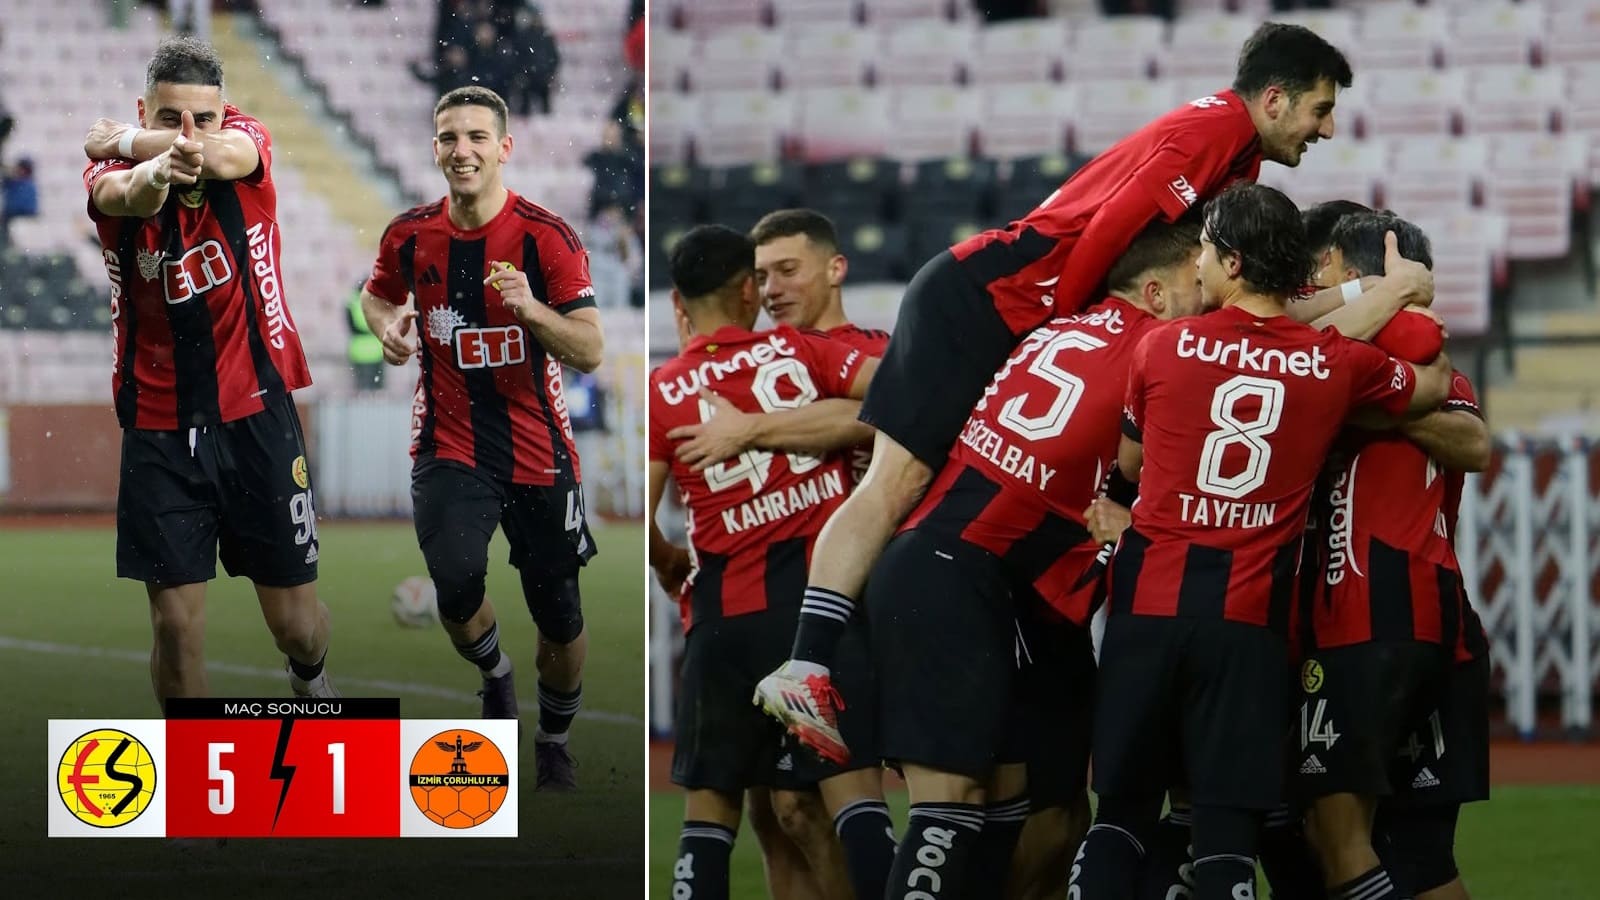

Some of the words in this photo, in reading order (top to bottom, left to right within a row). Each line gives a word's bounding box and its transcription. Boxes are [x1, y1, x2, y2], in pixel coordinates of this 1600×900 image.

[1176, 327, 1330, 380] turknet
[1196, 374, 1285, 499] 8
[1178, 493, 1277, 529] TAYFUN
[1300, 698, 1341, 752] 14
